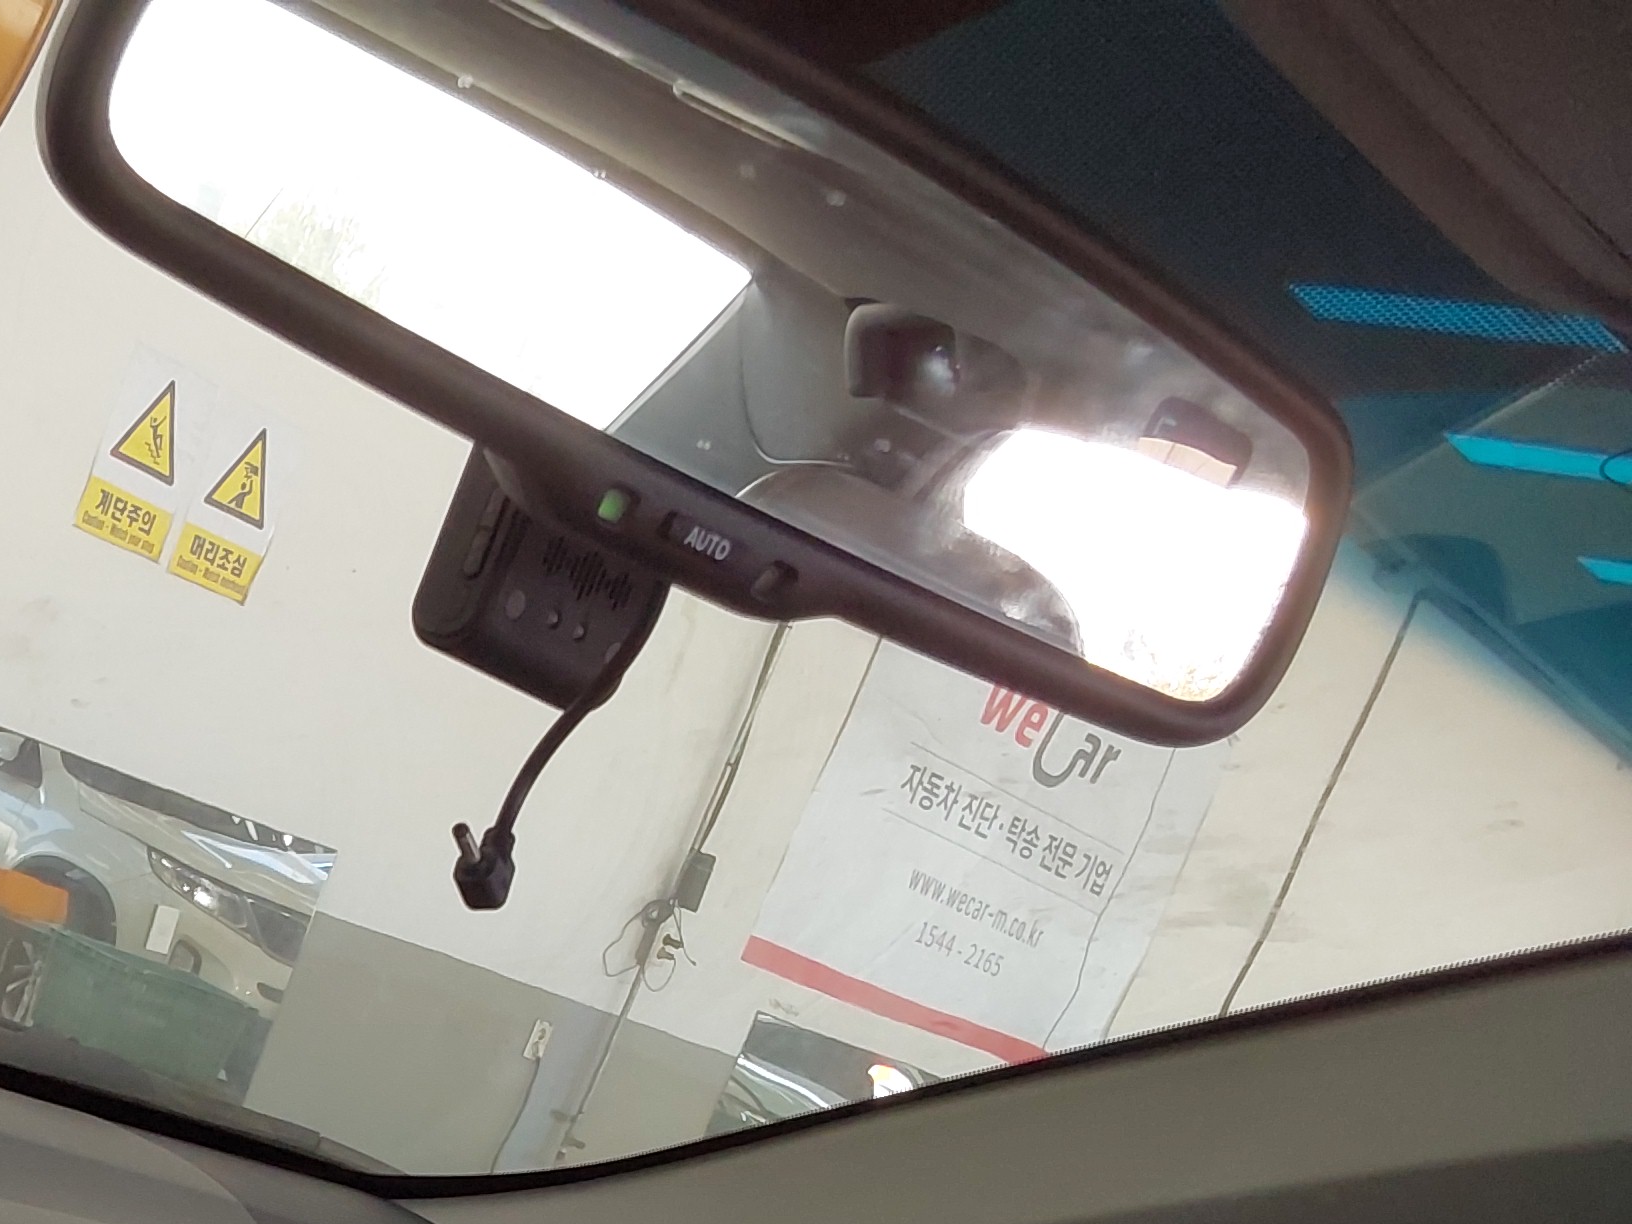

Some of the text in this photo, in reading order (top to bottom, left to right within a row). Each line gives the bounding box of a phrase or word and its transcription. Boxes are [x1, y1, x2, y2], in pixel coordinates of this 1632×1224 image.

[95, 488, 157, 536] 계단주의
[189, 533, 248, 579] 머리조심
[683, 526, 731, 561] AUTO
[900, 764, 962, 821] 자동차
[1039, 834, 1078, 879] 전문
[1074, 853, 1113, 896] 기업
[909, 868, 1045, 948] www.wecar-m.co.kr
